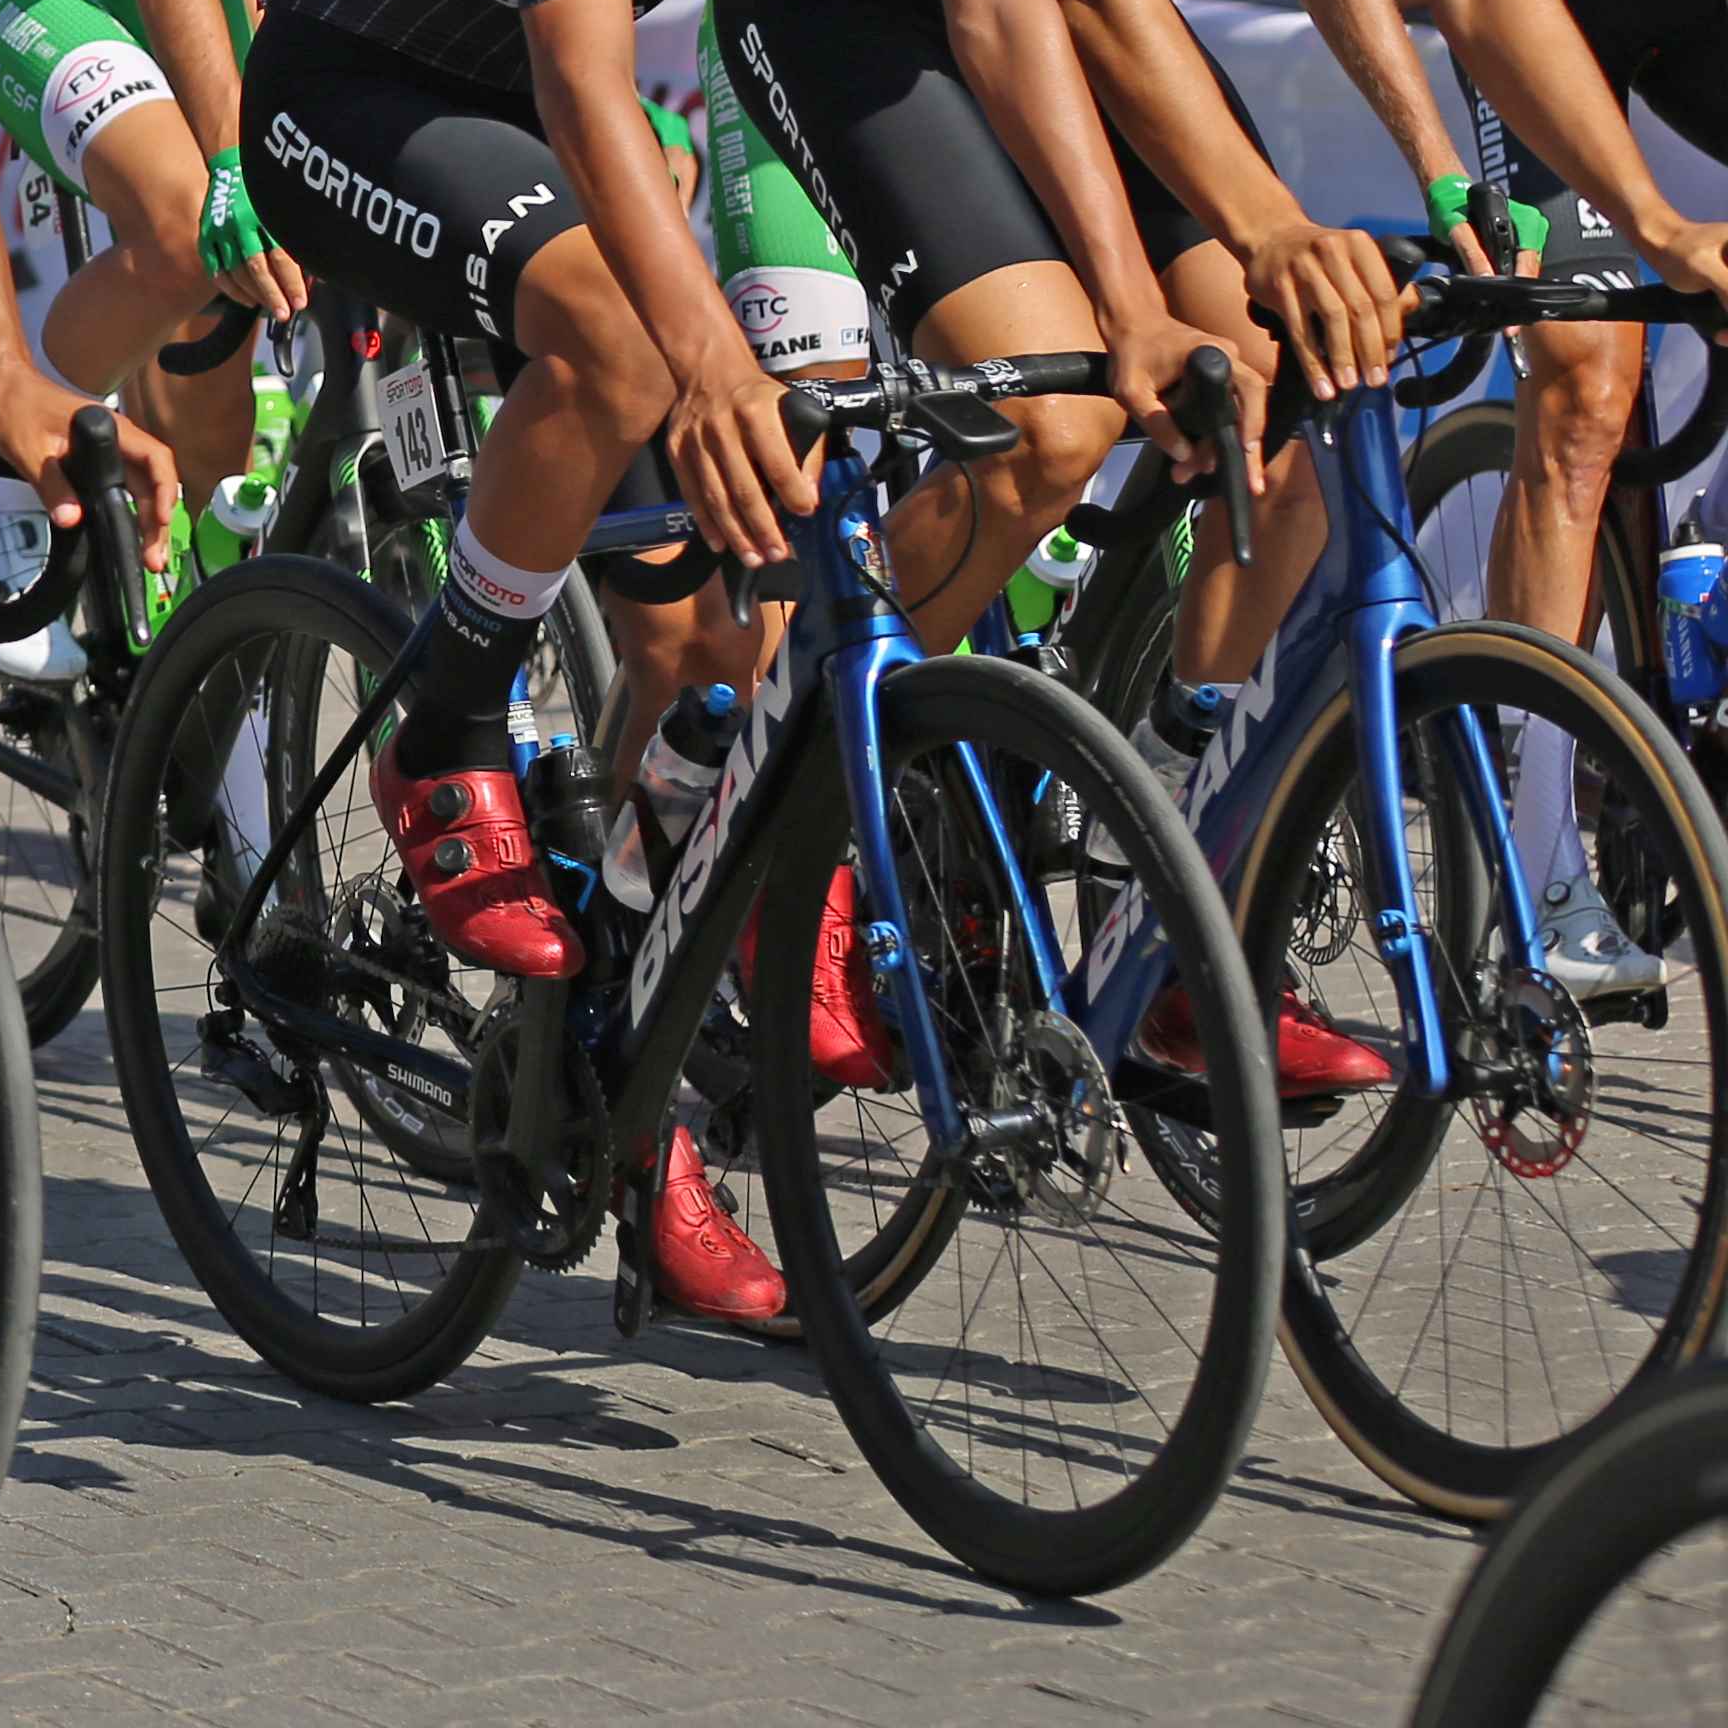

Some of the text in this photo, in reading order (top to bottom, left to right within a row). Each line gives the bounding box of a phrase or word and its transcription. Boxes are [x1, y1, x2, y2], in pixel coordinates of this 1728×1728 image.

[2, 73, 40, 115] CSF
[67, 57, 116, 96] FTC
[67, 79, 157, 150] FAIZANE
[739, 22, 859, 271] SPORTOTO
[263, 111, 441, 260] SPORTOTO
[739, 295, 791, 323] FTC
[754, 332, 823, 360] ZANE
[396, 406, 433, 477] 143
[387, 1063, 452, 1107] SHIMANO
